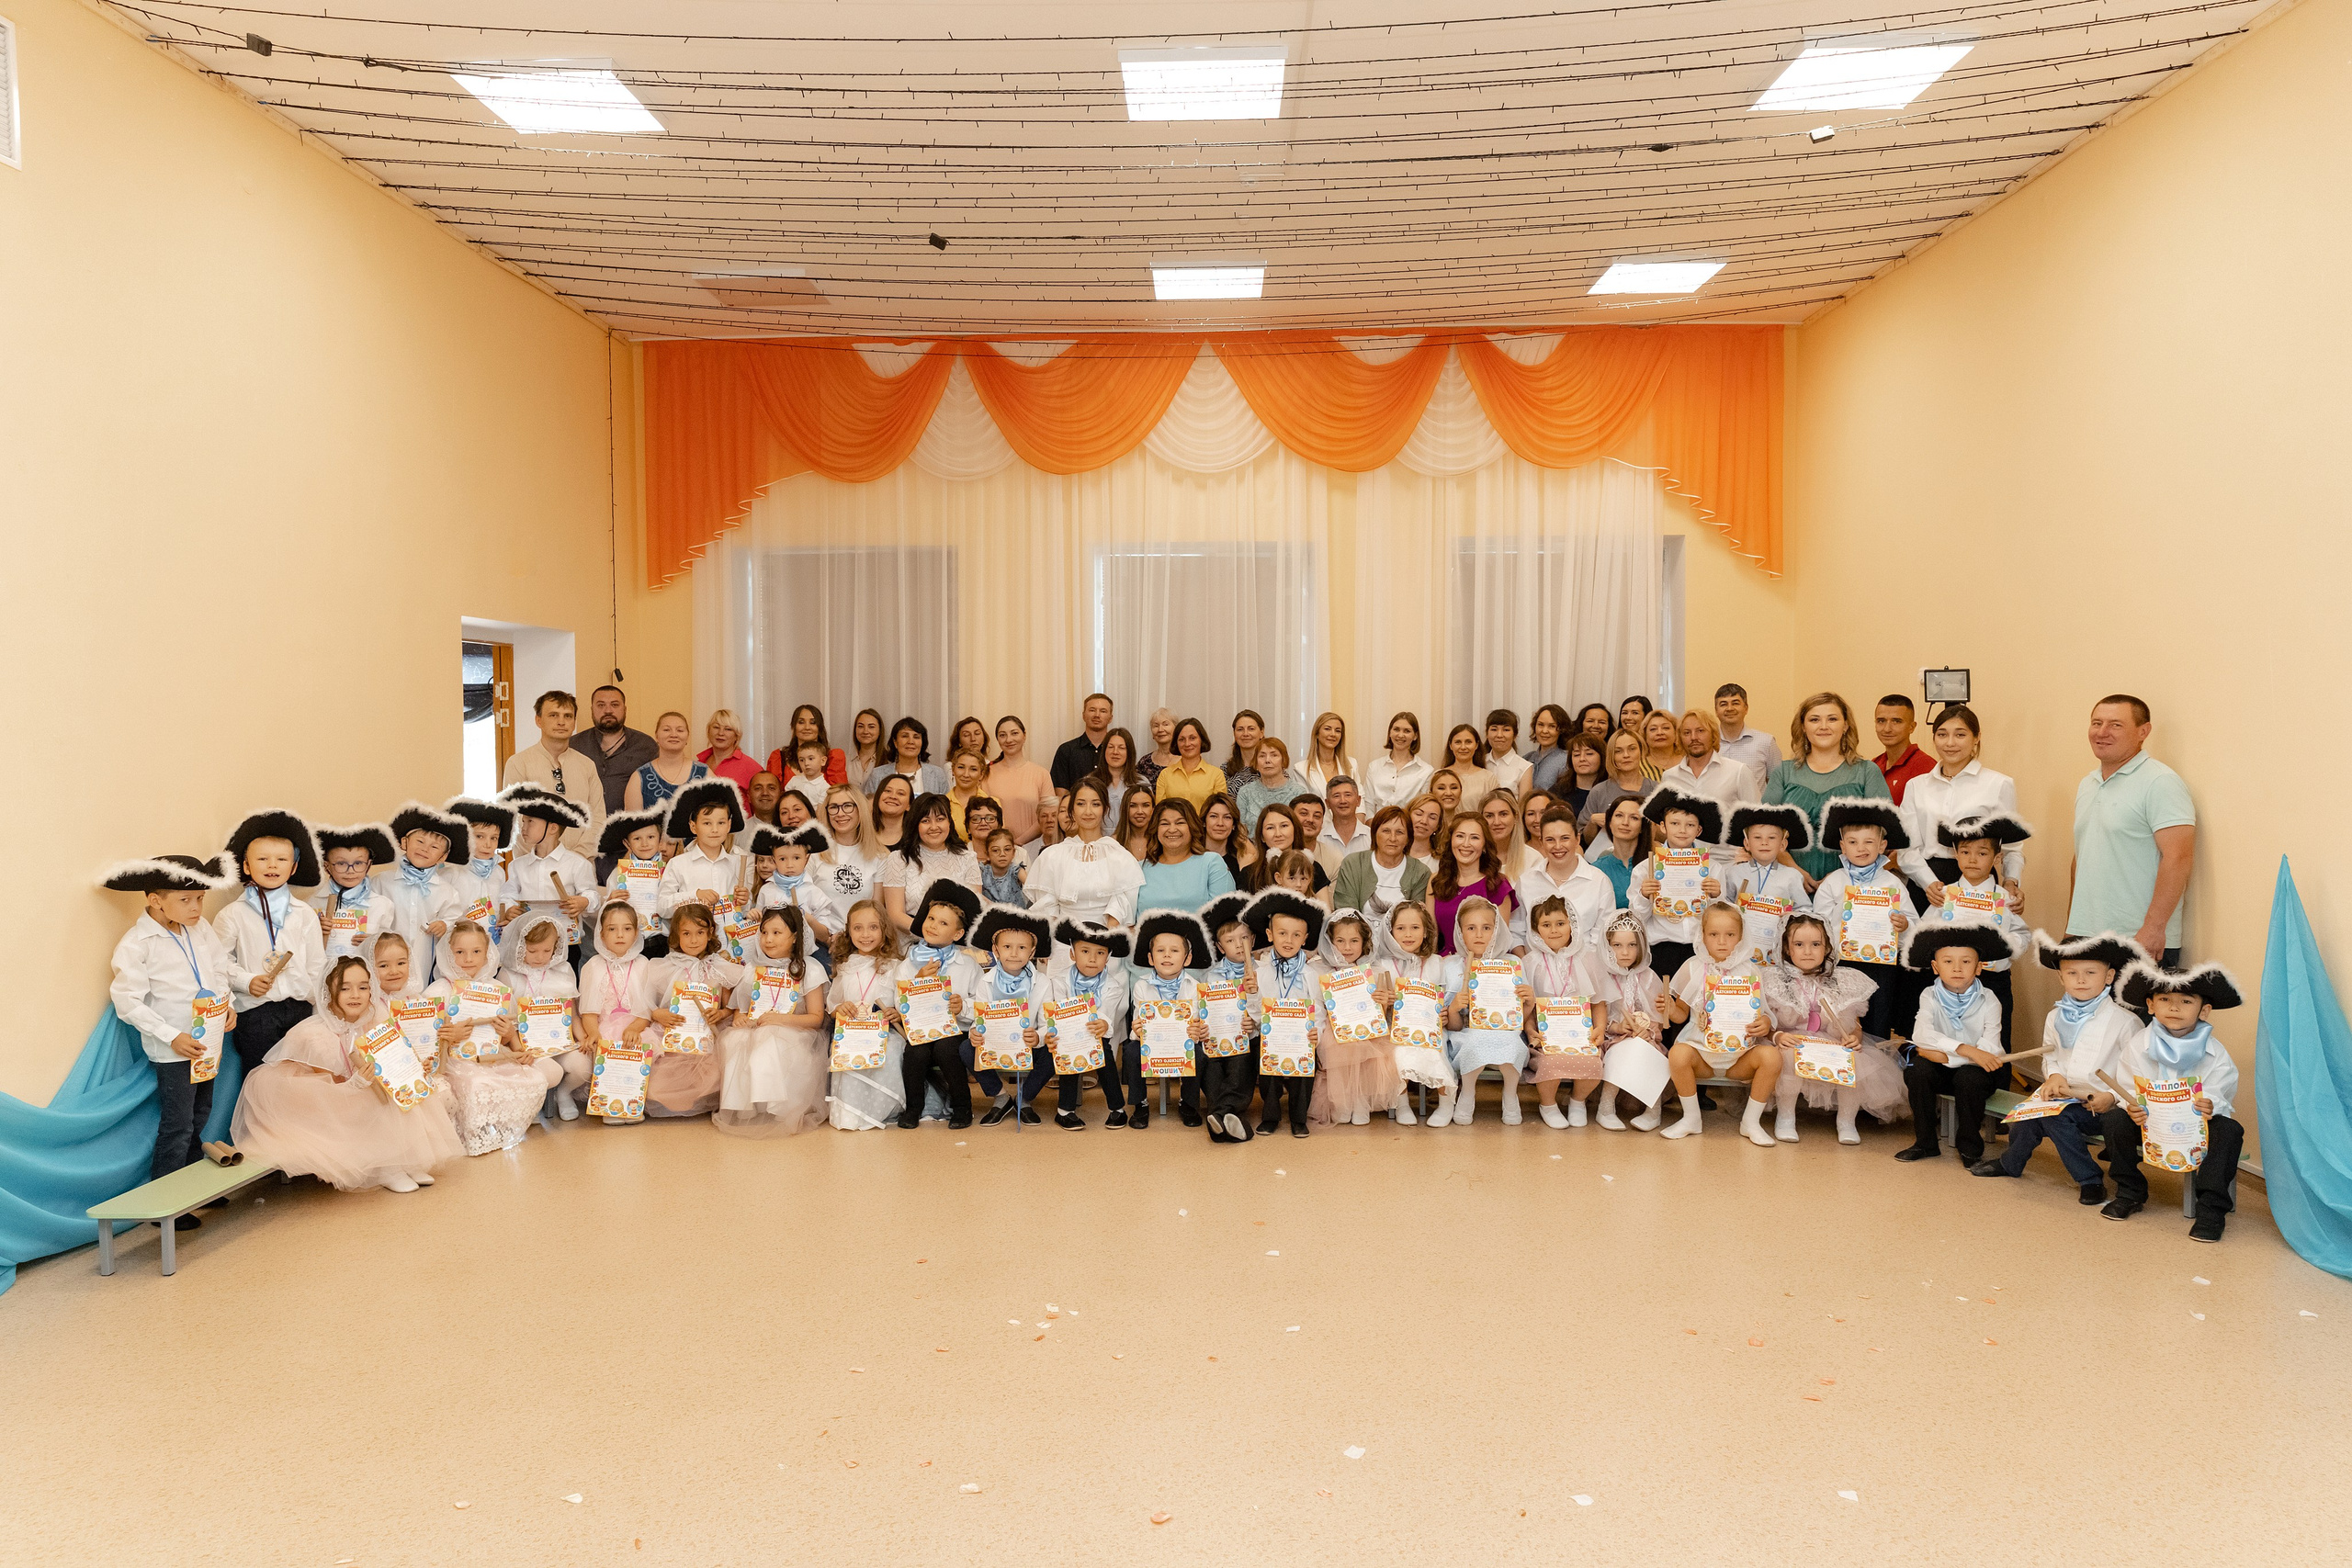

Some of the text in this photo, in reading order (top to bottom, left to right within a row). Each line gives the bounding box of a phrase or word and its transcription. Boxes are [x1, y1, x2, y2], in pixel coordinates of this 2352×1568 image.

[1856, 888, 1889, 897] ДИПЛОМ
[1959, 890, 1992, 900] ДИПЛОМ
[1749, 896, 1781, 906] ДИПЛОМ
[1330, 968, 1361, 981] ДИПЛОМ
[910, 978, 940, 987] ДИПЛОМ
[1206, 983, 1234, 991] ДИПЛОМ
[1406, 980, 1435, 990] ДИПЛОМ
[466, 985, 500, 994] ДИПЛОМ
[684, 985, 713, 994] ДИПЛОМ
[402, 1001, 435, 1010] ДИПЛОМ
[985, 1001, 1017, 1010] ДИПЛОМ
[1055, 998, 1085, 1010] ДИПЛОМ
[367, 1022, 393, 1043] ДИПЛОМ
[2146, 1080, 2188, 1090] ДИПЛОМ
